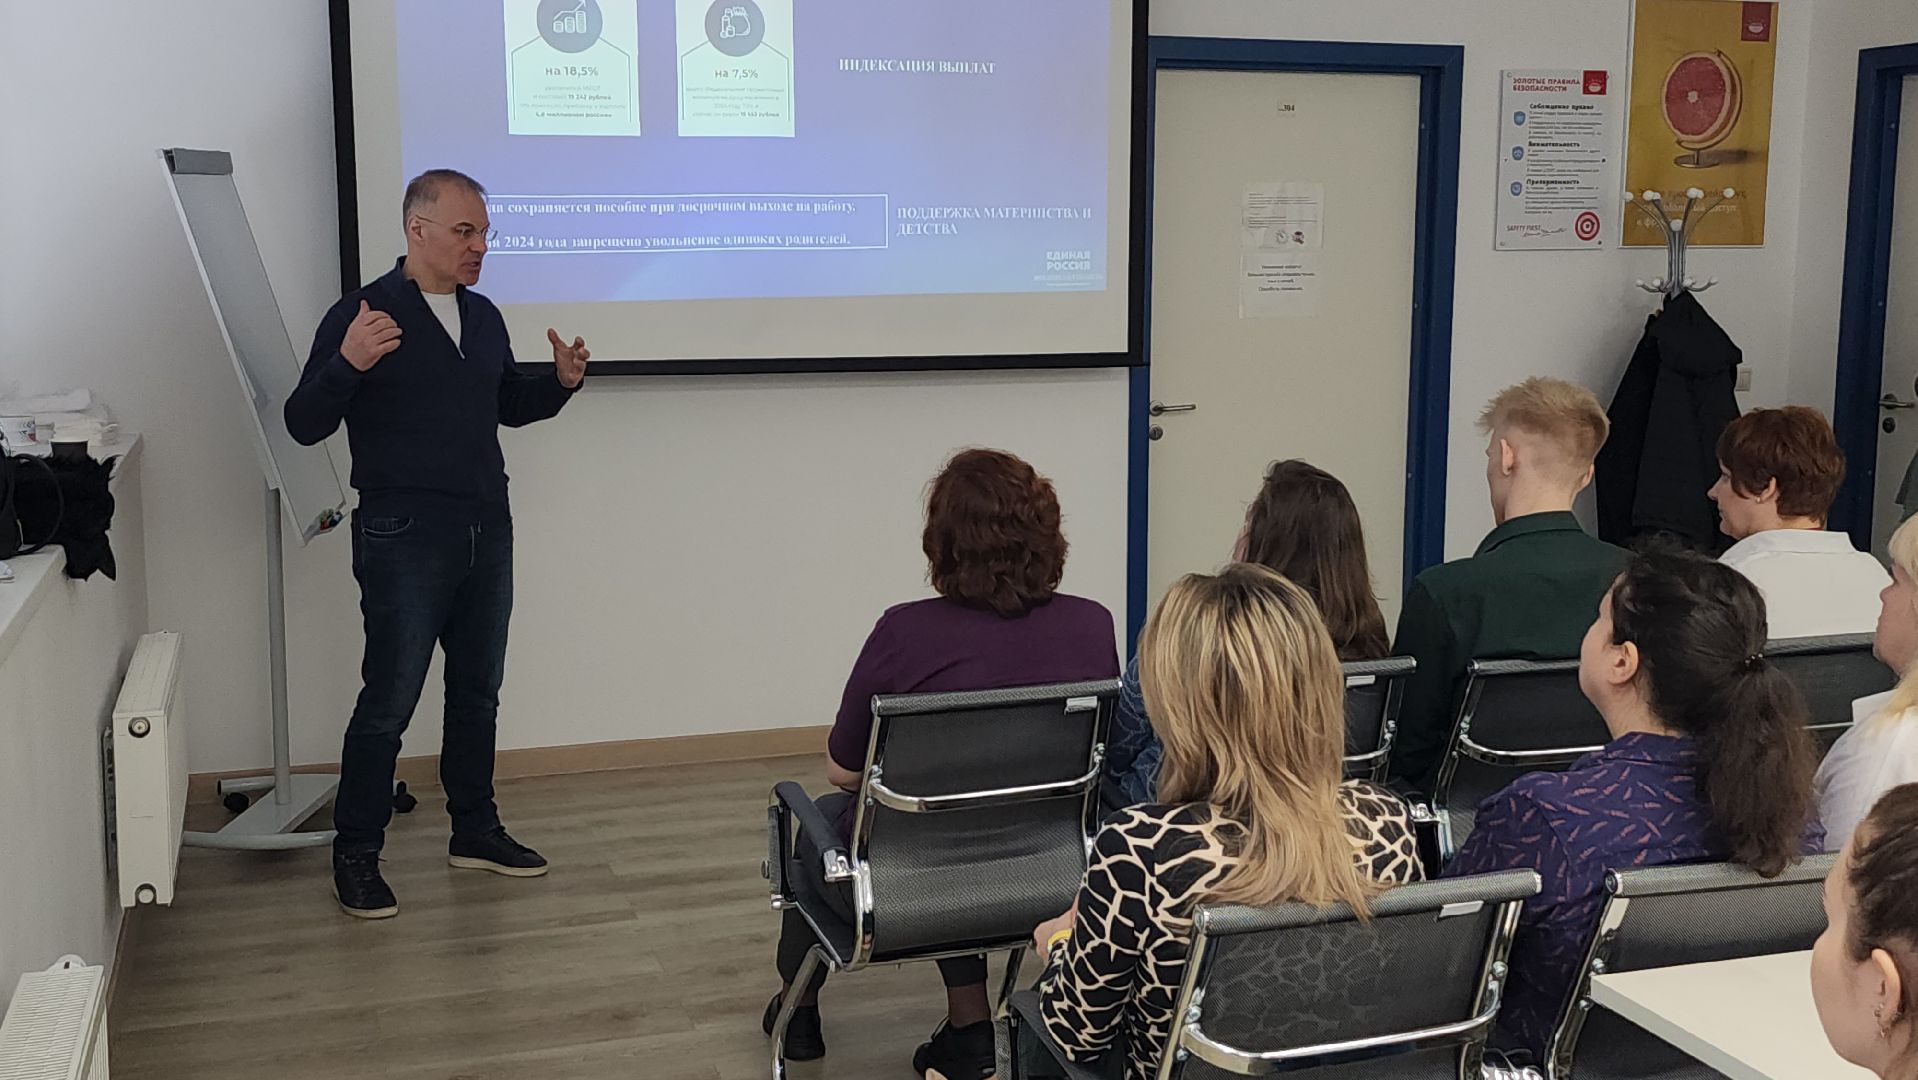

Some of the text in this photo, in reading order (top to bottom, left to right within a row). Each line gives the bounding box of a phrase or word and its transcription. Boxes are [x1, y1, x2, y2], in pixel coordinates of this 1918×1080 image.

[545, 66, 599, 78] на 18,5%
[839, 58, 996, 74] ИНДЕКСАЦИЯ ВЫПЛАТ
[715, 69, 759, 80] на 7,5%
[1528, 140, 1581, 148] Внимательность
[1526, 179, 1580, 187] Приверженность
[507, 203, 591, 216] сохраняется
[595, 201, 647, 213] пособие
[650, 203, 674, 216] при
[677, 201, 746, 215] досрочном
[749, 202, 793, 213] выходе
[796, 203, 811, 213] на
[814, 200, 856, 215] работу.
[897, 206, 1092, 221] ПОДДЕРЖКА МАТЕРИНСТВА И
[896, 223, 958, 237] ДЕТСТВА
[504, 236, 535, 248] 2024
[538, 238, 568, 249] года
[571, 238, 642, 250] запрещено
[643, 236, 721, 249] увольнение
[723, 235, 783, 246] одиноких
[785, 234, 851, 247] родителей.
[1046, 251, 1091, 261] ЕДИНАЯ
[1046, 261, 1091, 271] РОССИЯ
